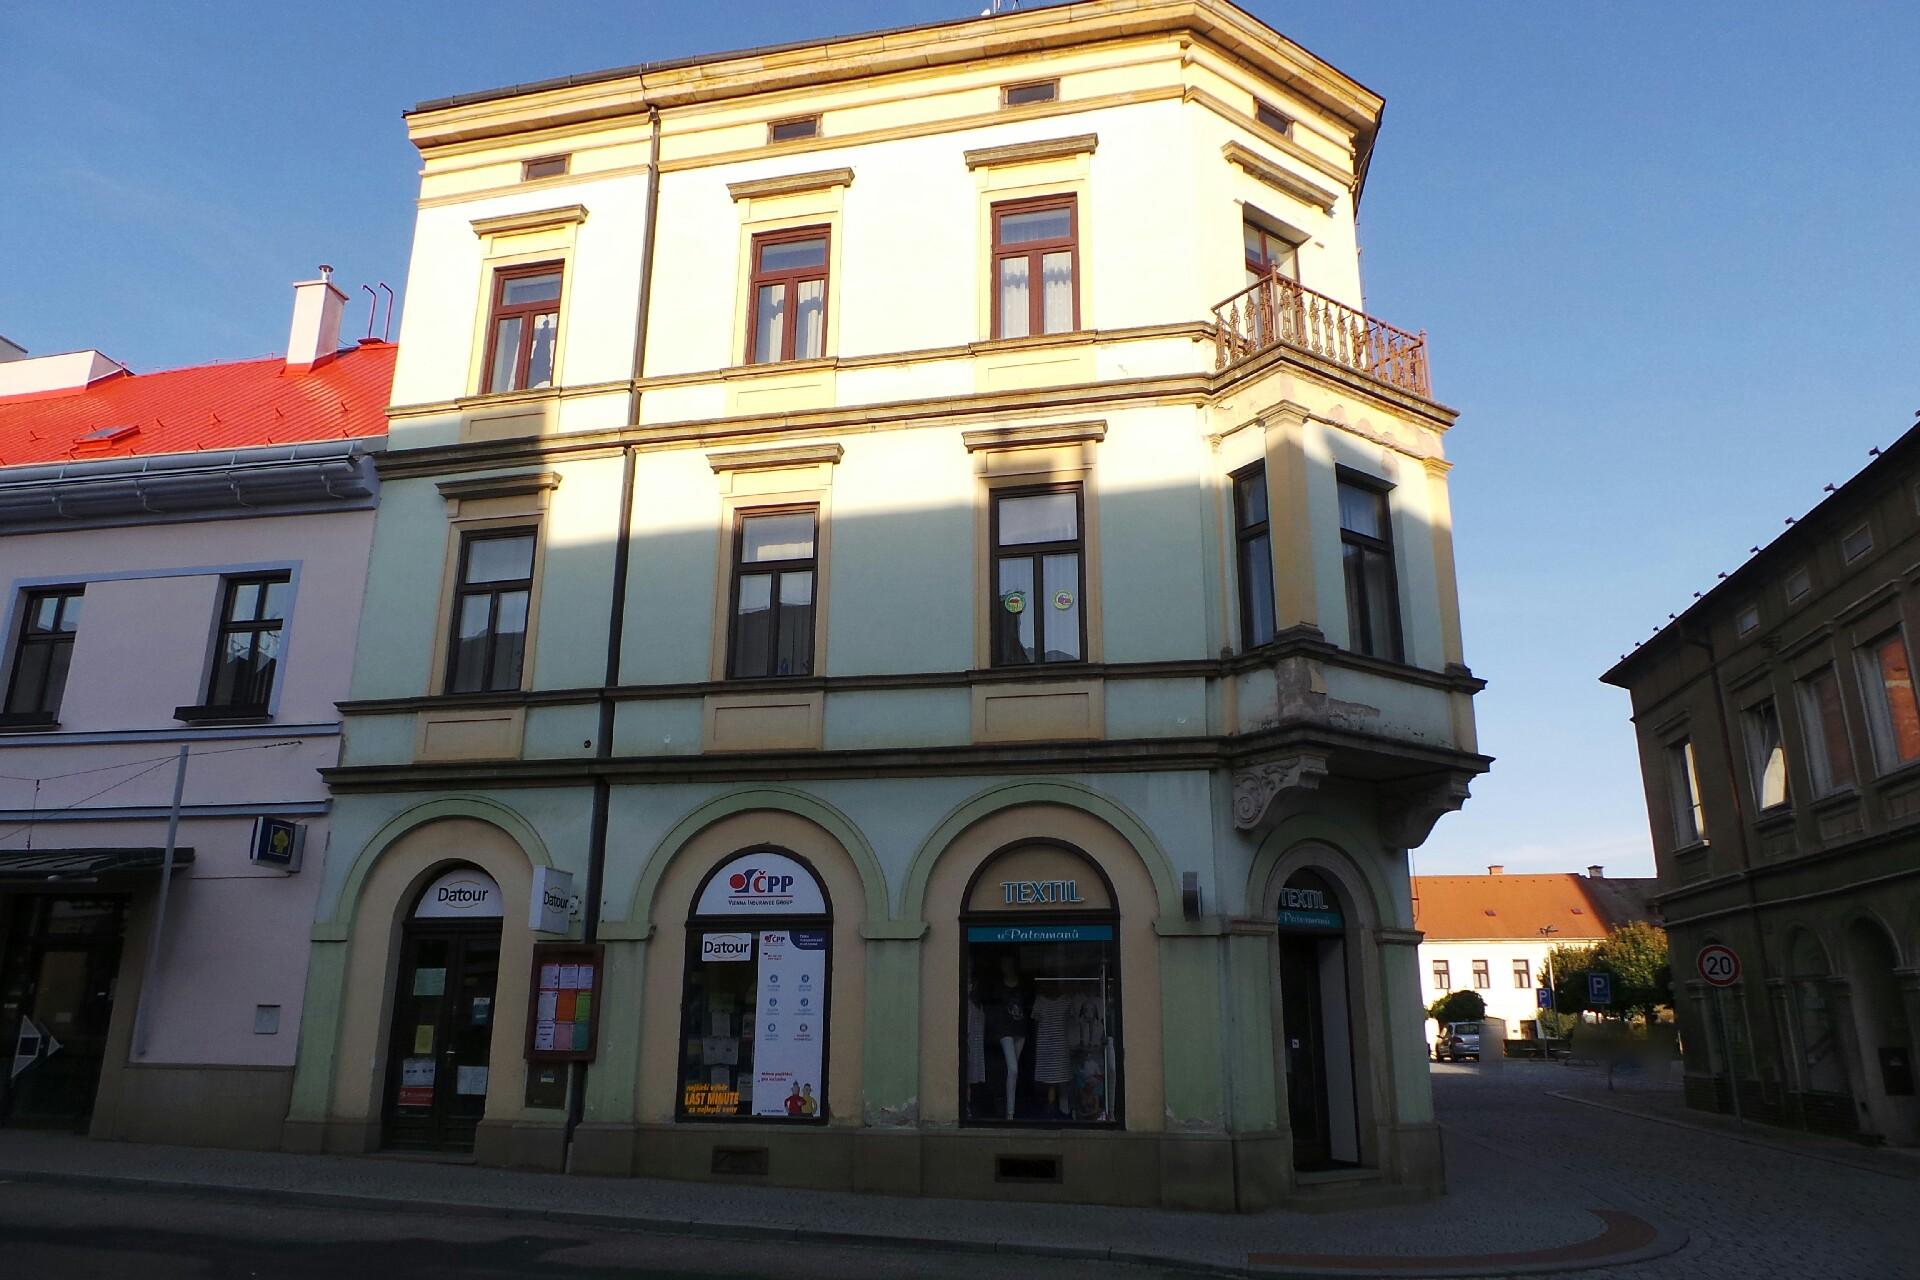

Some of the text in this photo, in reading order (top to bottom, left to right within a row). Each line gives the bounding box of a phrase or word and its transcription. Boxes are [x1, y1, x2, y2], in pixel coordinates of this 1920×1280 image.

[753, 870, 794, 894] ČPP
[1000, 879, 1085, 904] TEXTIL
[438, 887, 489, 902] Datour
[543, 891, 569, 910] Datour
[1280, 887, 1329, 910] TEXTIL
[703, 941, 750, 954] Datour
[1706, 956, 1732, 975] 20
[1592, 976, 1605, 995] P
[685, 1092, 740, 1105] LAST MINUTE
